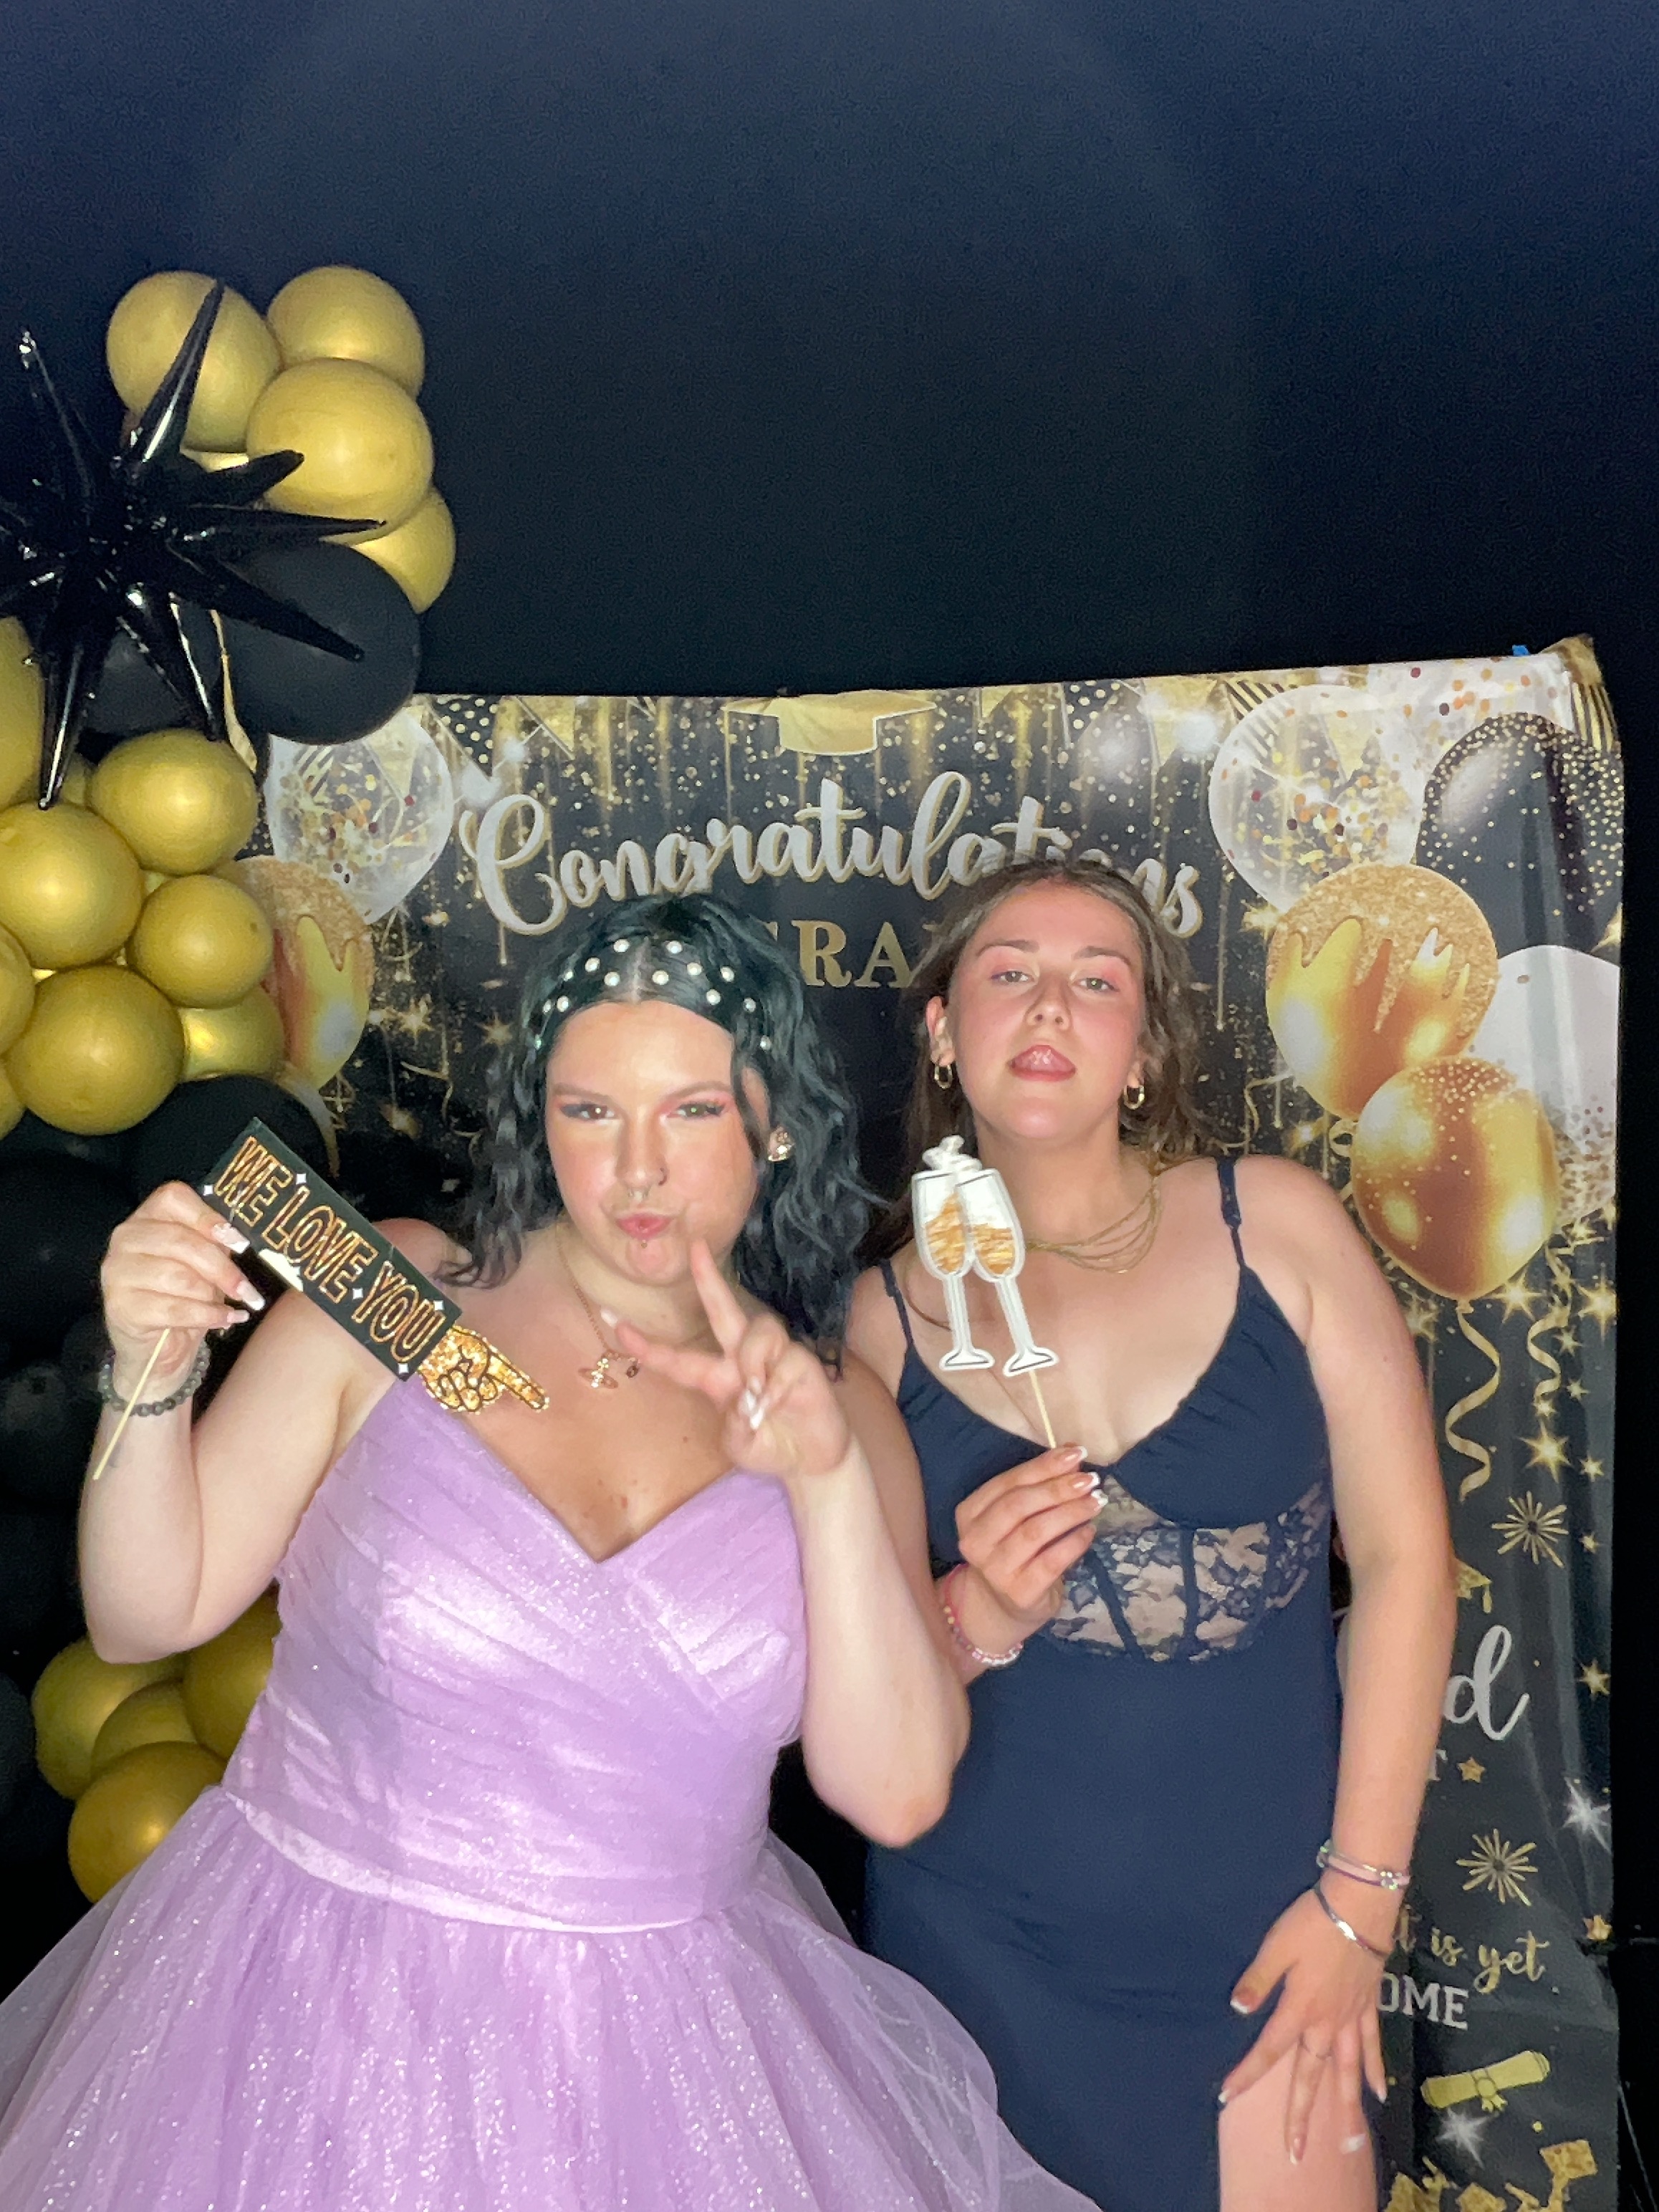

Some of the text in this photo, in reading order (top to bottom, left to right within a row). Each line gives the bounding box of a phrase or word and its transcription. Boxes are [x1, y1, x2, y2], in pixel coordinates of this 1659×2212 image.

[458, 771, 1203, 938] Congratulatns
[213, 1135, 446, 1363] WE LOVE YOU
[1431, 1926, 1463, 1967] is
[1473, 1930, 1550, 1994] yet
